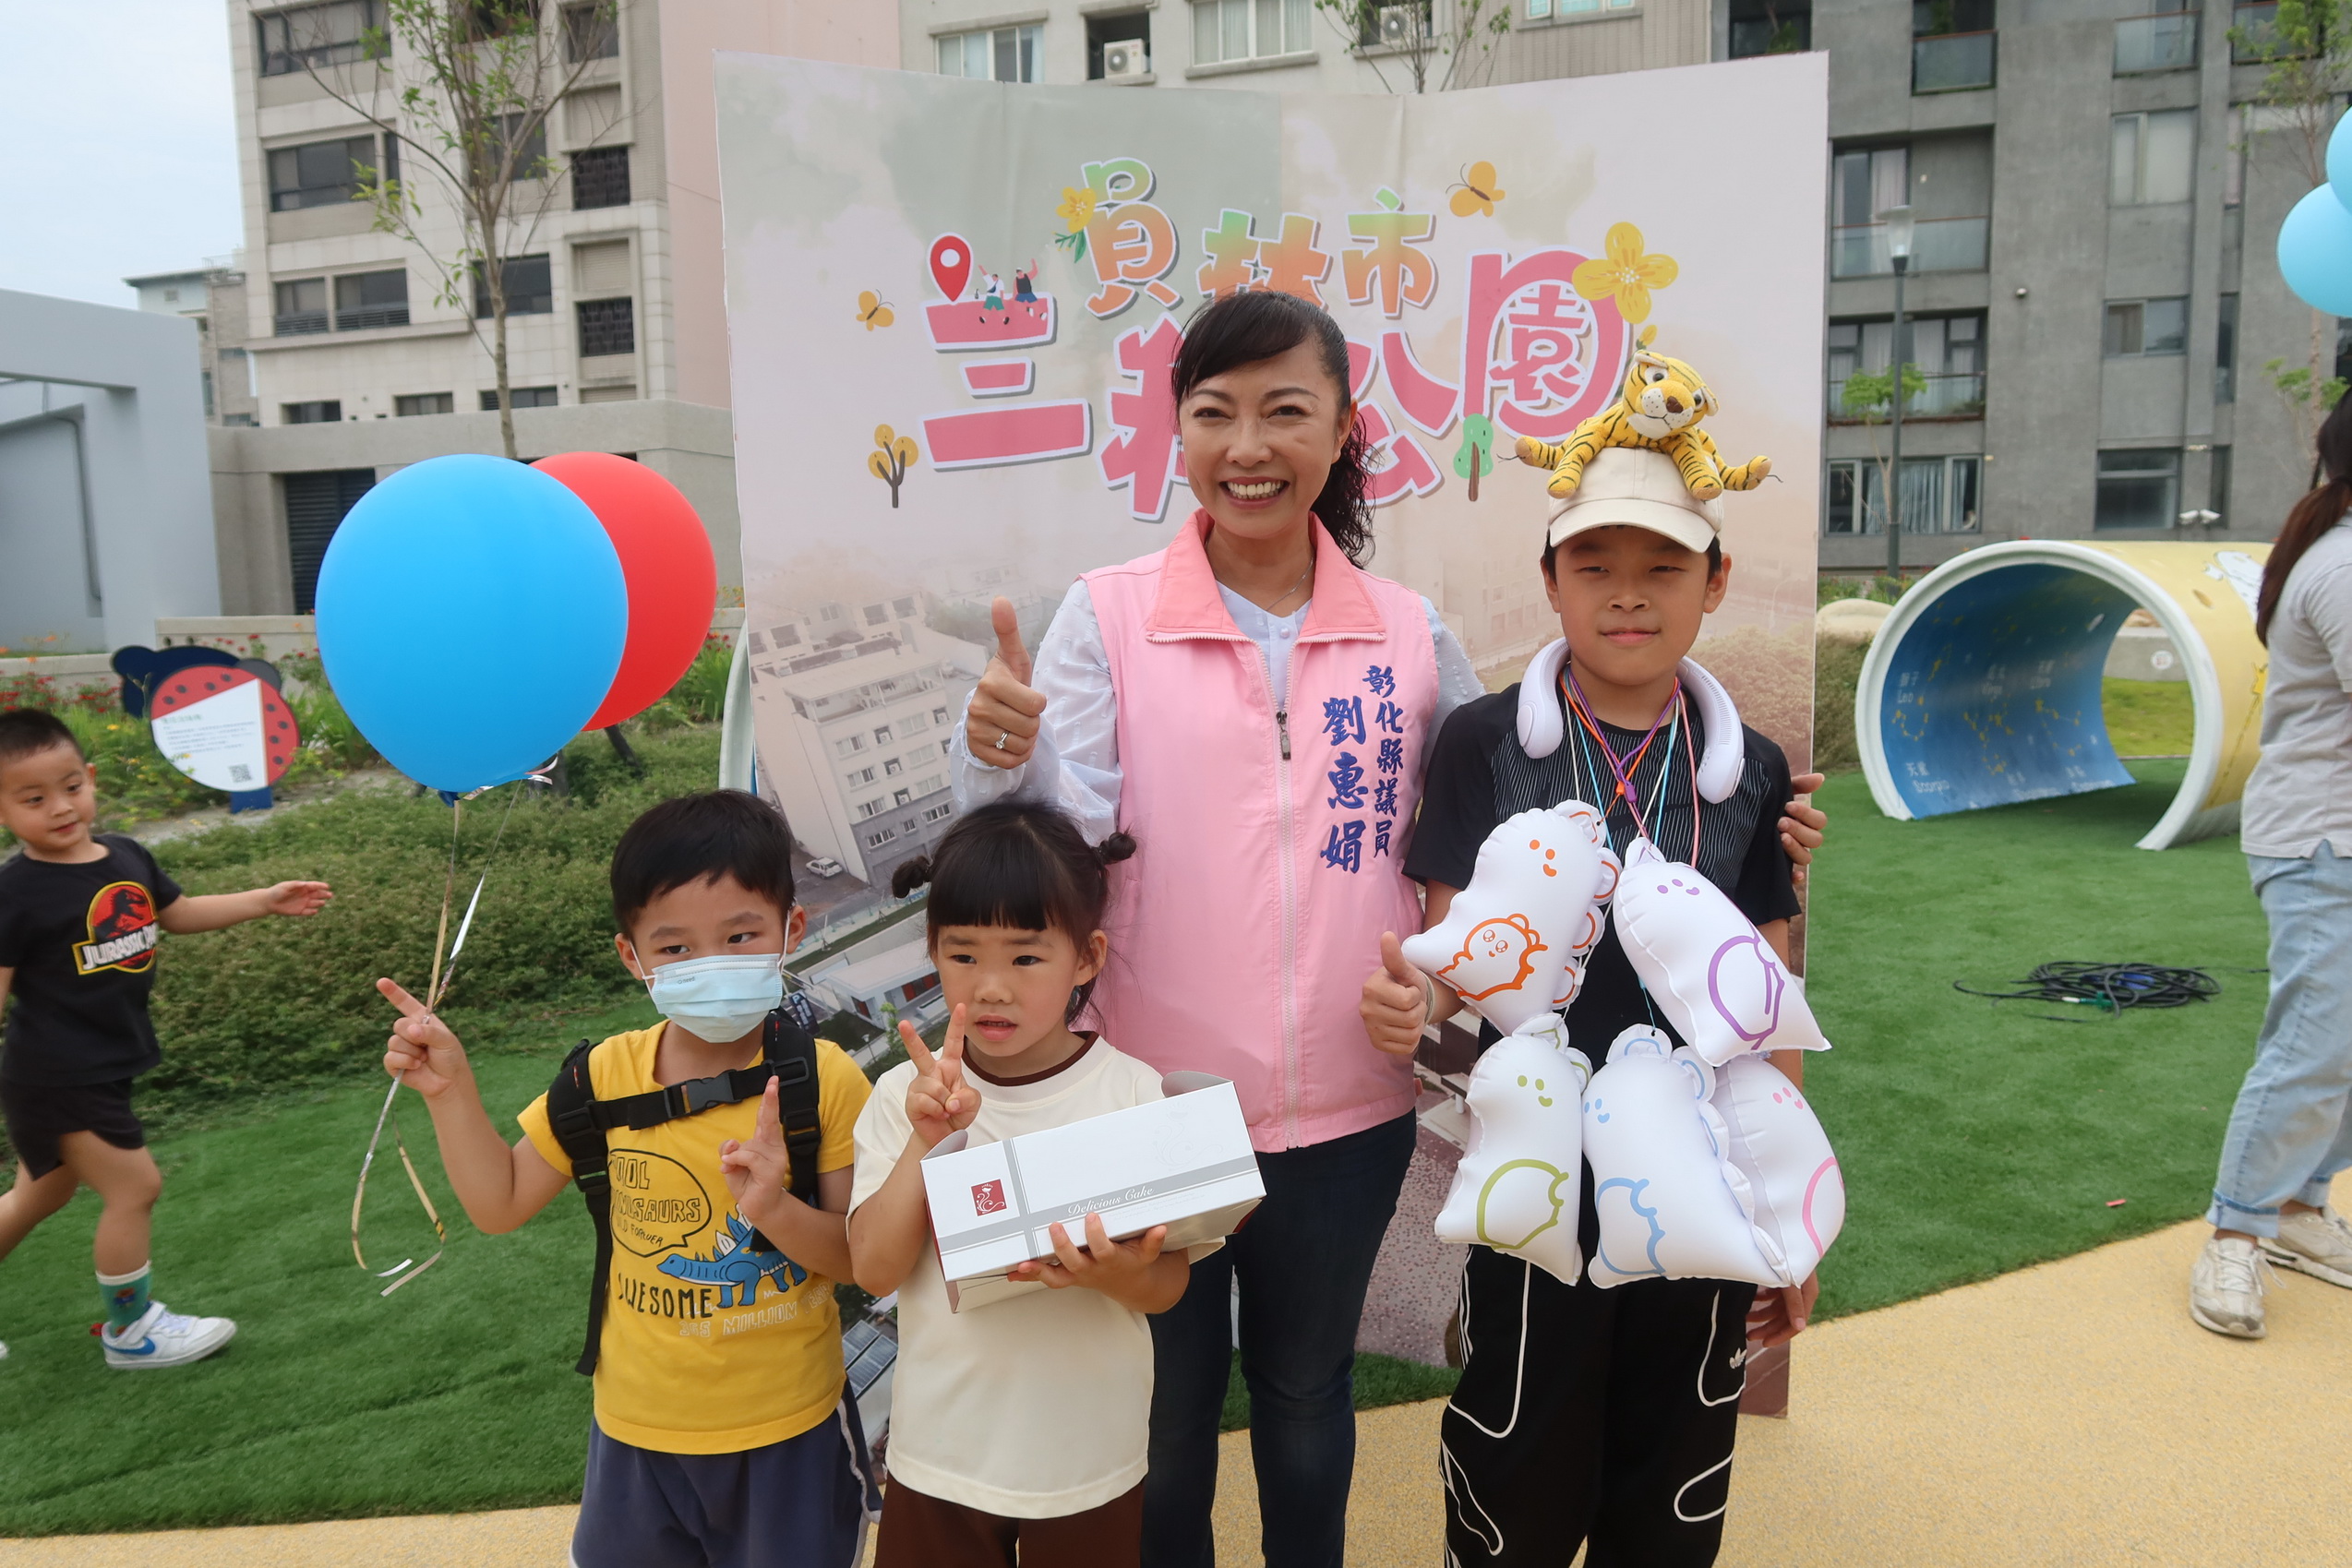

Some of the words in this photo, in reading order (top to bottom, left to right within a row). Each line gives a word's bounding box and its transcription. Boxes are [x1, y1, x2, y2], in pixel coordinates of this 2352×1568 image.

[1082, 156, 1436, 318] 員林市
[1320, 696, 1369, 874] 劉惠娟
[1362, 665, 1403, 857] 彰化縣議員
[609, 1154, 650, 1190] OOL
[1068, 1196, 1121, 1216] Delicious
[1125, 1185, 1155, 1201] Cake
[723, 1301, 798, 1335] MILLION
